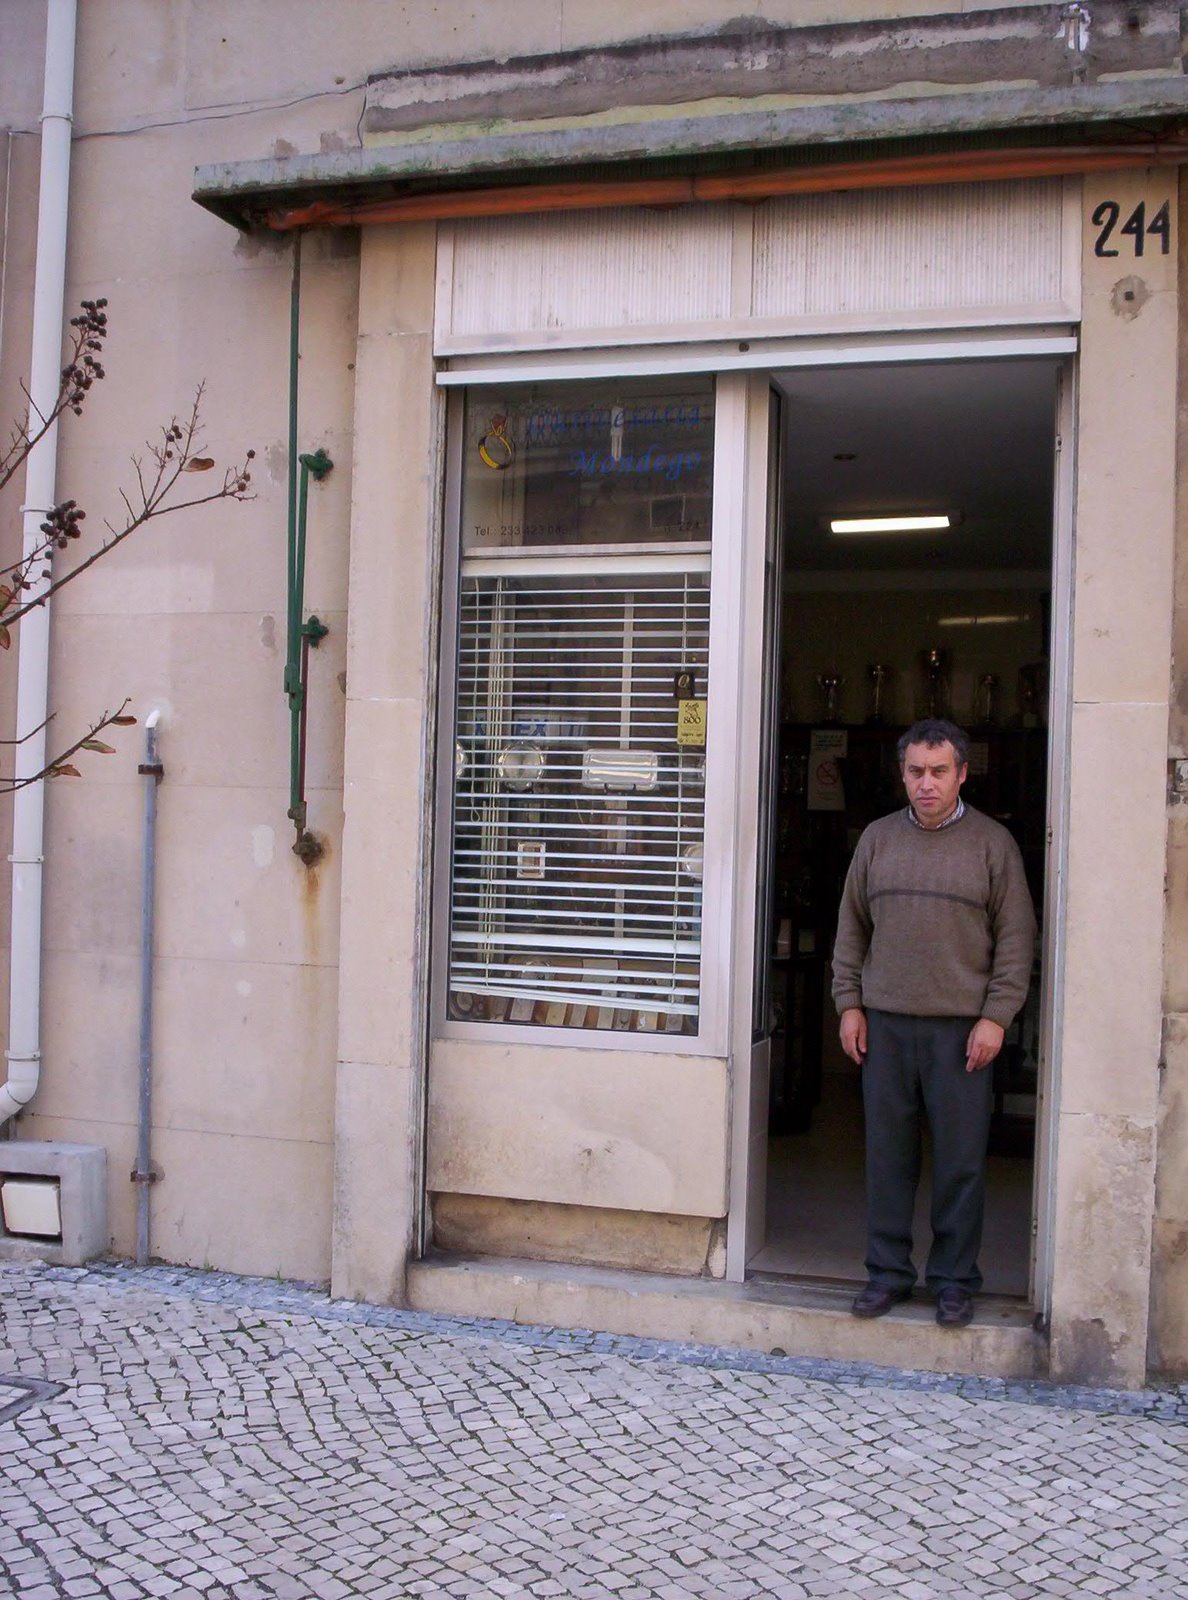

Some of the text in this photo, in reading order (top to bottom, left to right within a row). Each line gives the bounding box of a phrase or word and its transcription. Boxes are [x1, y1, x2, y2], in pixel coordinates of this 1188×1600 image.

[1092, 199, 1170, 257] 244
[568, 444, 700, 480] Mondego
[500, 526, 520, 537] 233
